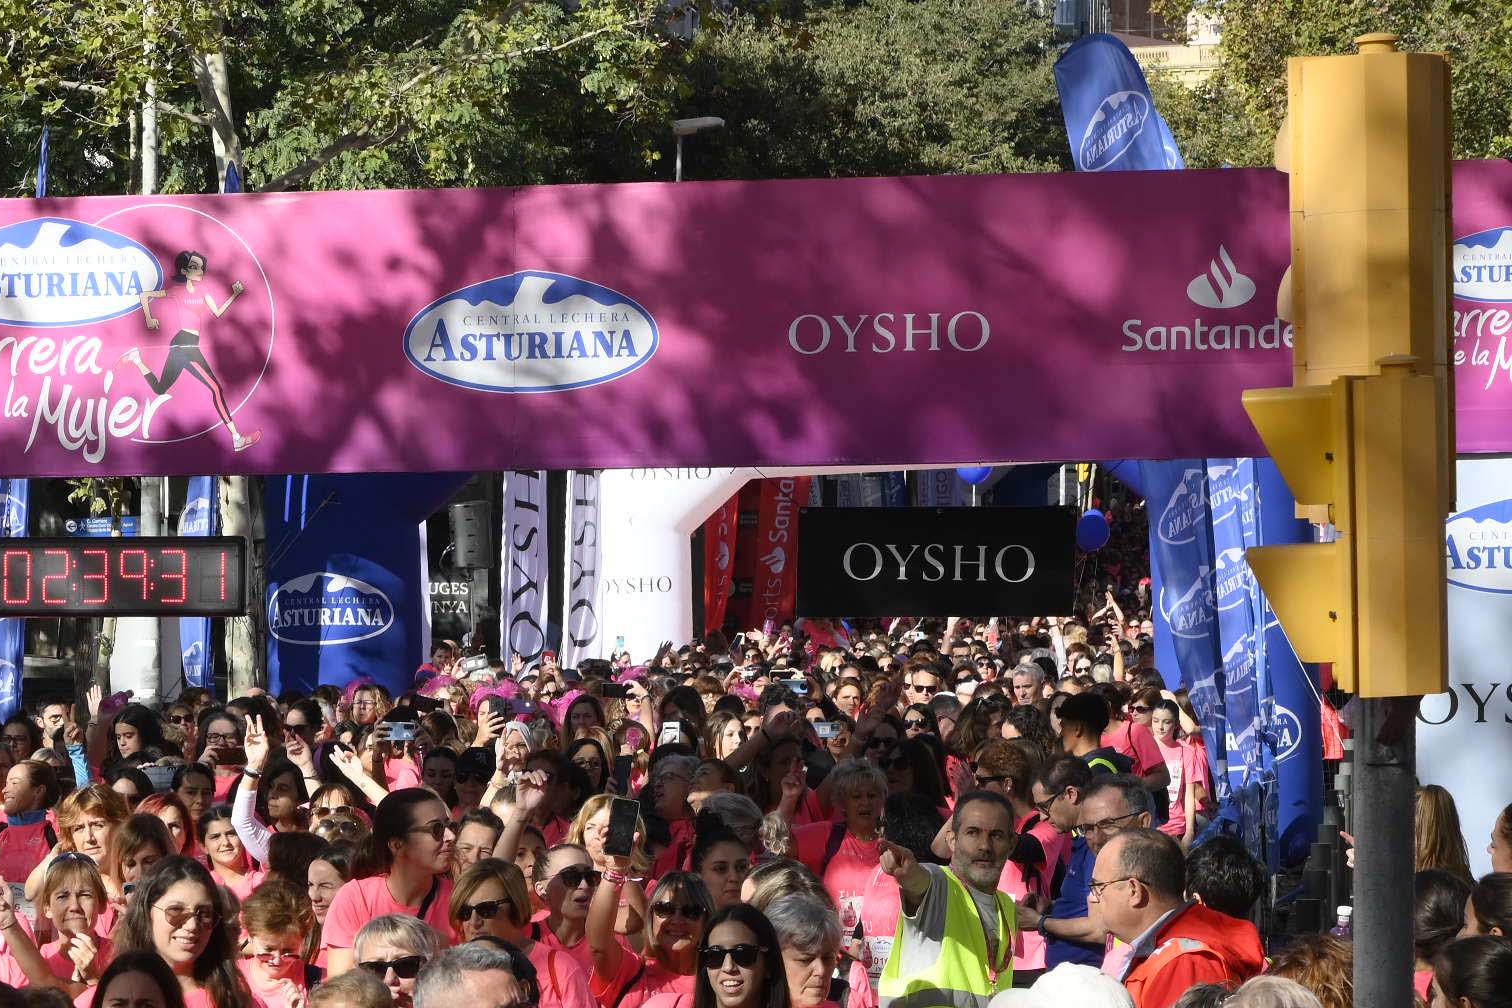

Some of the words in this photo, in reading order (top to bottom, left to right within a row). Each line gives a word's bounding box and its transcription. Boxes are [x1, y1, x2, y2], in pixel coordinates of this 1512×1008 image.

[463, 313, 541, 326] CENTRAL
[550, 311, 630, 323] LECHERA
[787, 311, 991, 355] OYSHO
[1121, 317, 1294, 352] Santande
[423, 318, 639, 362] ASTURIANA
[1471, 339, 1489, 366] la
[3, 379, 29, 418] la
[24, 370, 173, 463] Mujer
[3, 550, 227, 604] 02:39:31
[842, 542, 1036, 583] OYSHO
[271, 600, 385, 629] ASTURIANA
